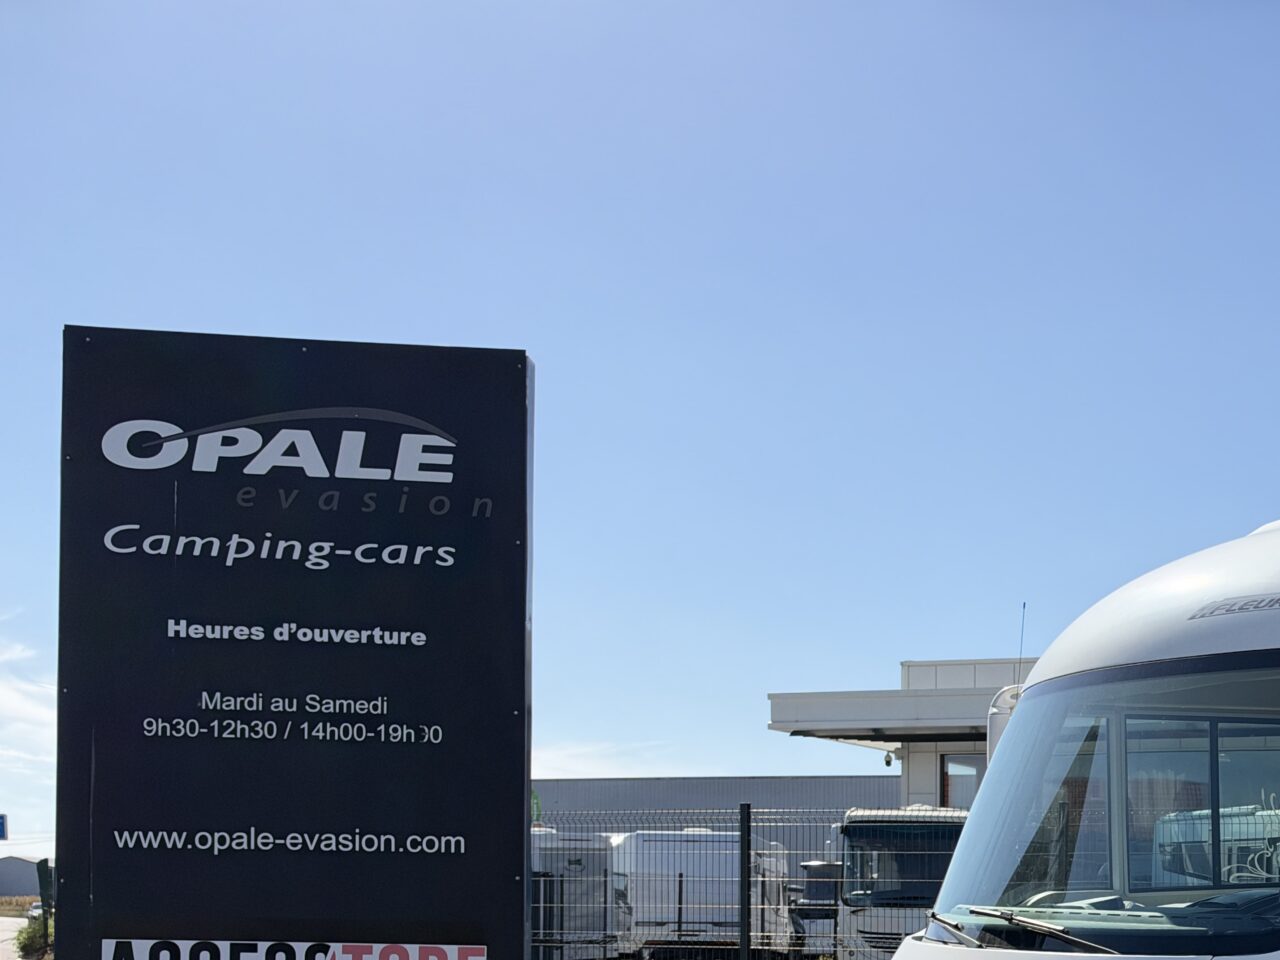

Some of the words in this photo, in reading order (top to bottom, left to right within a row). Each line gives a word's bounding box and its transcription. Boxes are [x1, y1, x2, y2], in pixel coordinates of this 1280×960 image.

[102, 419, 456, 483] OPALE
[236, 486, 493, 518] evasion
[103, 524, 456, 570] Camping-cars
[167, 619, 265, 641] Heures
[273, 622, 427, 646] d'ouverture
[202, 691, 263, 711] Mardi
[270, 697, 297, 712] au
[305, 694, 388, 715] Samedi
[143, 717, 277, 739] 9h30-12h30
[113, 826, 465, 856] www.opale-evasion.com
